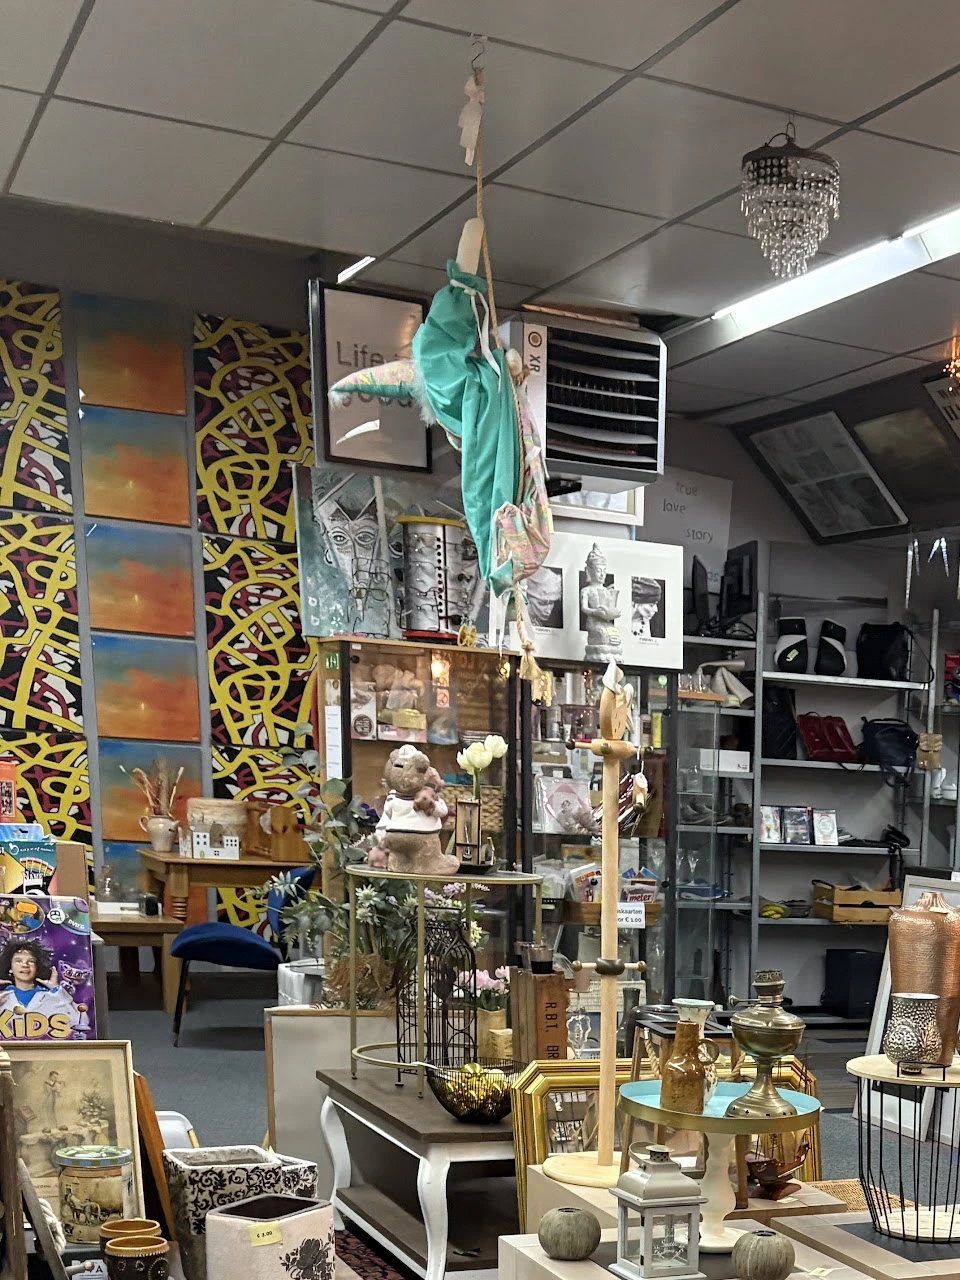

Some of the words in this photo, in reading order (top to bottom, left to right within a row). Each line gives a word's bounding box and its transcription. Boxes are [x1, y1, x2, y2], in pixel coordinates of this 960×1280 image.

[336, 340, 386, 369] Life
[676, 482, 698, 496] true
[662, 499, 687, 514] love
[685, 528, 714, 544] story
